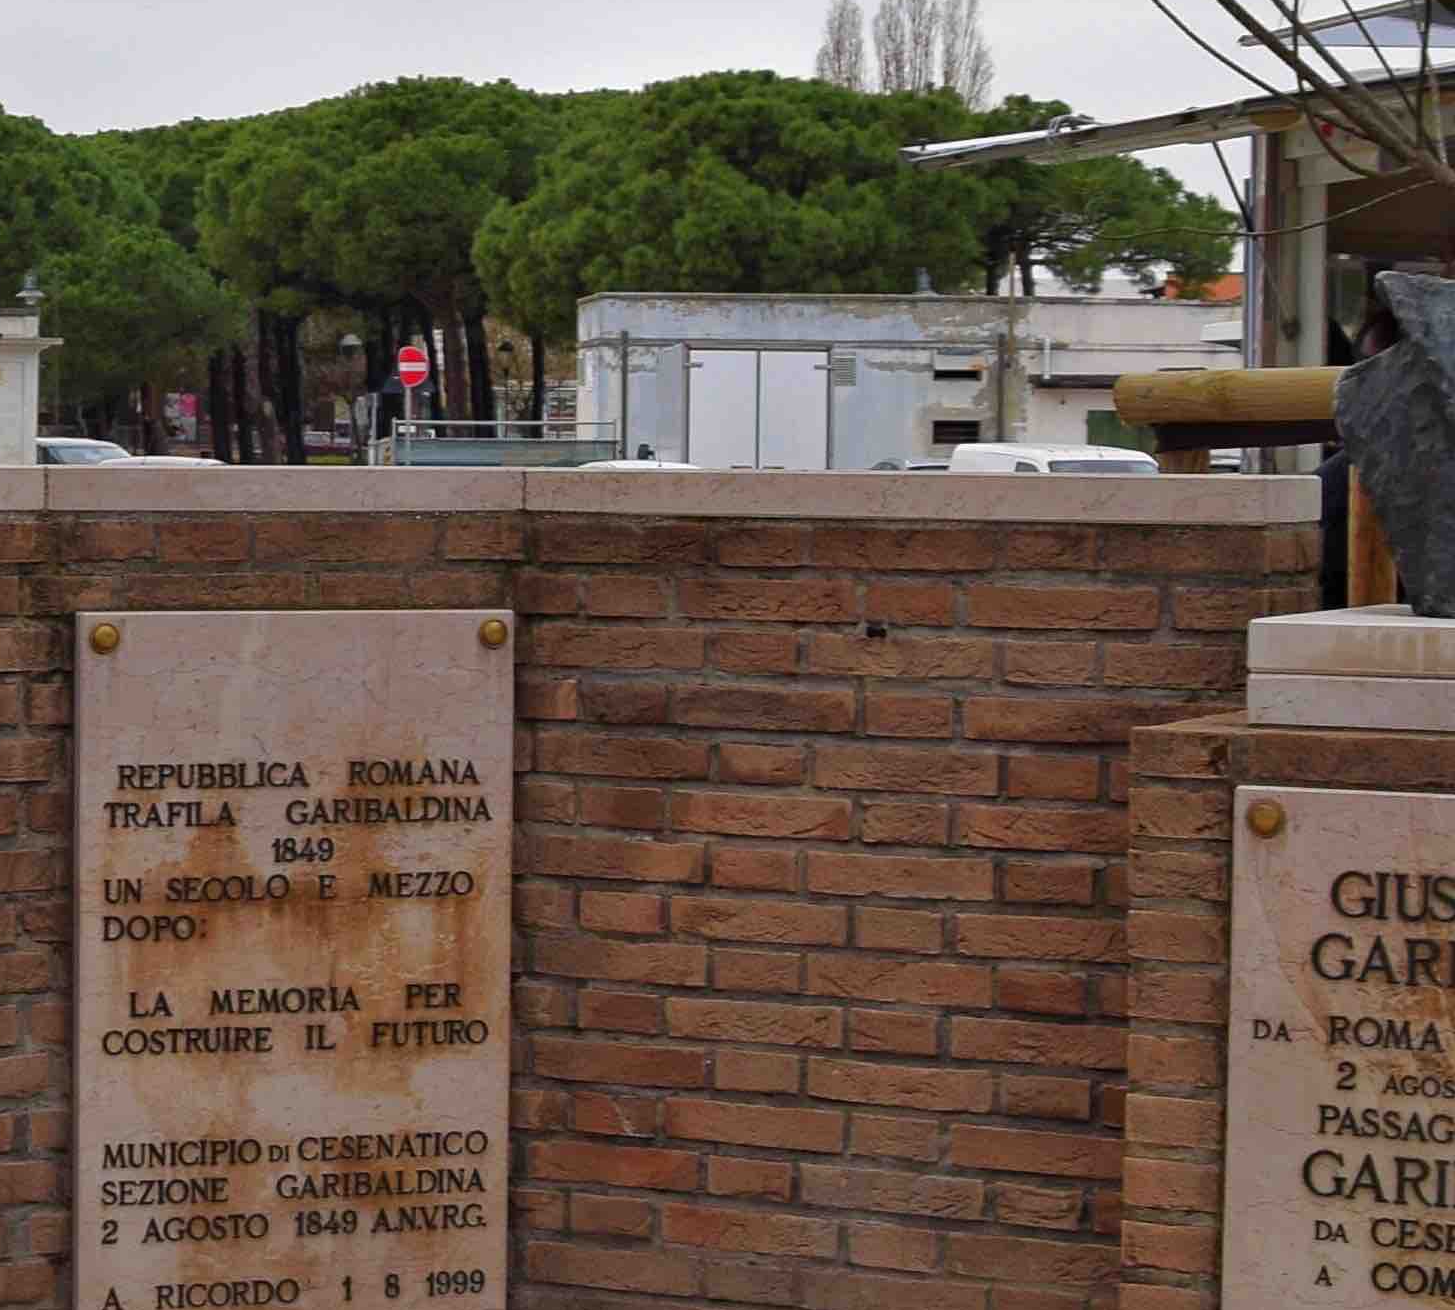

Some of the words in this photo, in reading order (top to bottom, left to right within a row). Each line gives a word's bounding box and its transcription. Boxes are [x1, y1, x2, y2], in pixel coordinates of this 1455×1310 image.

[117, 762, 309, 789] REPUBBLICA
[348, 760, 479, 787] ROMANA
[104, 801, 236, 828] TRAFILA
[286, 797, 492, 825] GARIBALDINA
[272, 837, 334, 863] 1849
[104, 878, 142, 904] UN
[166, 875, 288, 903] SECOLO
[318, 875, 337, 899] E
[369, 871, 474, 897] MEZZO
[102, 915, 207, 943] DOPO:
[129, 991, 172, 1018] LA
[210, 986, 360, 1015] MEMORIA
[406, 983, 461, 1010] PER
[102, 1026, 272, 1056] COSTRUIRE
[307, 1024, 336, 1051] IL
[372, 1020, 488, 1048] FUTURO
[1253, 1018, 1292, 1043] DA
[1328, 1016, 1445, 1053] ROMA
[1336, 1062, 1357, 1091] 2
[103, 1139, 261, 1169] MUNICIPIO
[269, 1147, 289, 1162] DI
[297, 1130, 488, 1161] CESENATICO
[100, 1178, 228, 1206] SEZIONE
[277, 1169, 486, 1199] GARIBALDINA
[101, 1220, 118, 1245] 2
[141, 1214, 269, 1243] AGOSTO
[295, 1211, 358, 1236] 1849
[1314, 1219, 1350, 1245] DA
[155, 1279, 300, 1310] RICORDO
[343, 1277, 353, 1301] 1
[384, 1274, 400, 1298] 8
[426, 1270, 486, 1297] 1999
[1314, 1265, 1333, 1286] A
